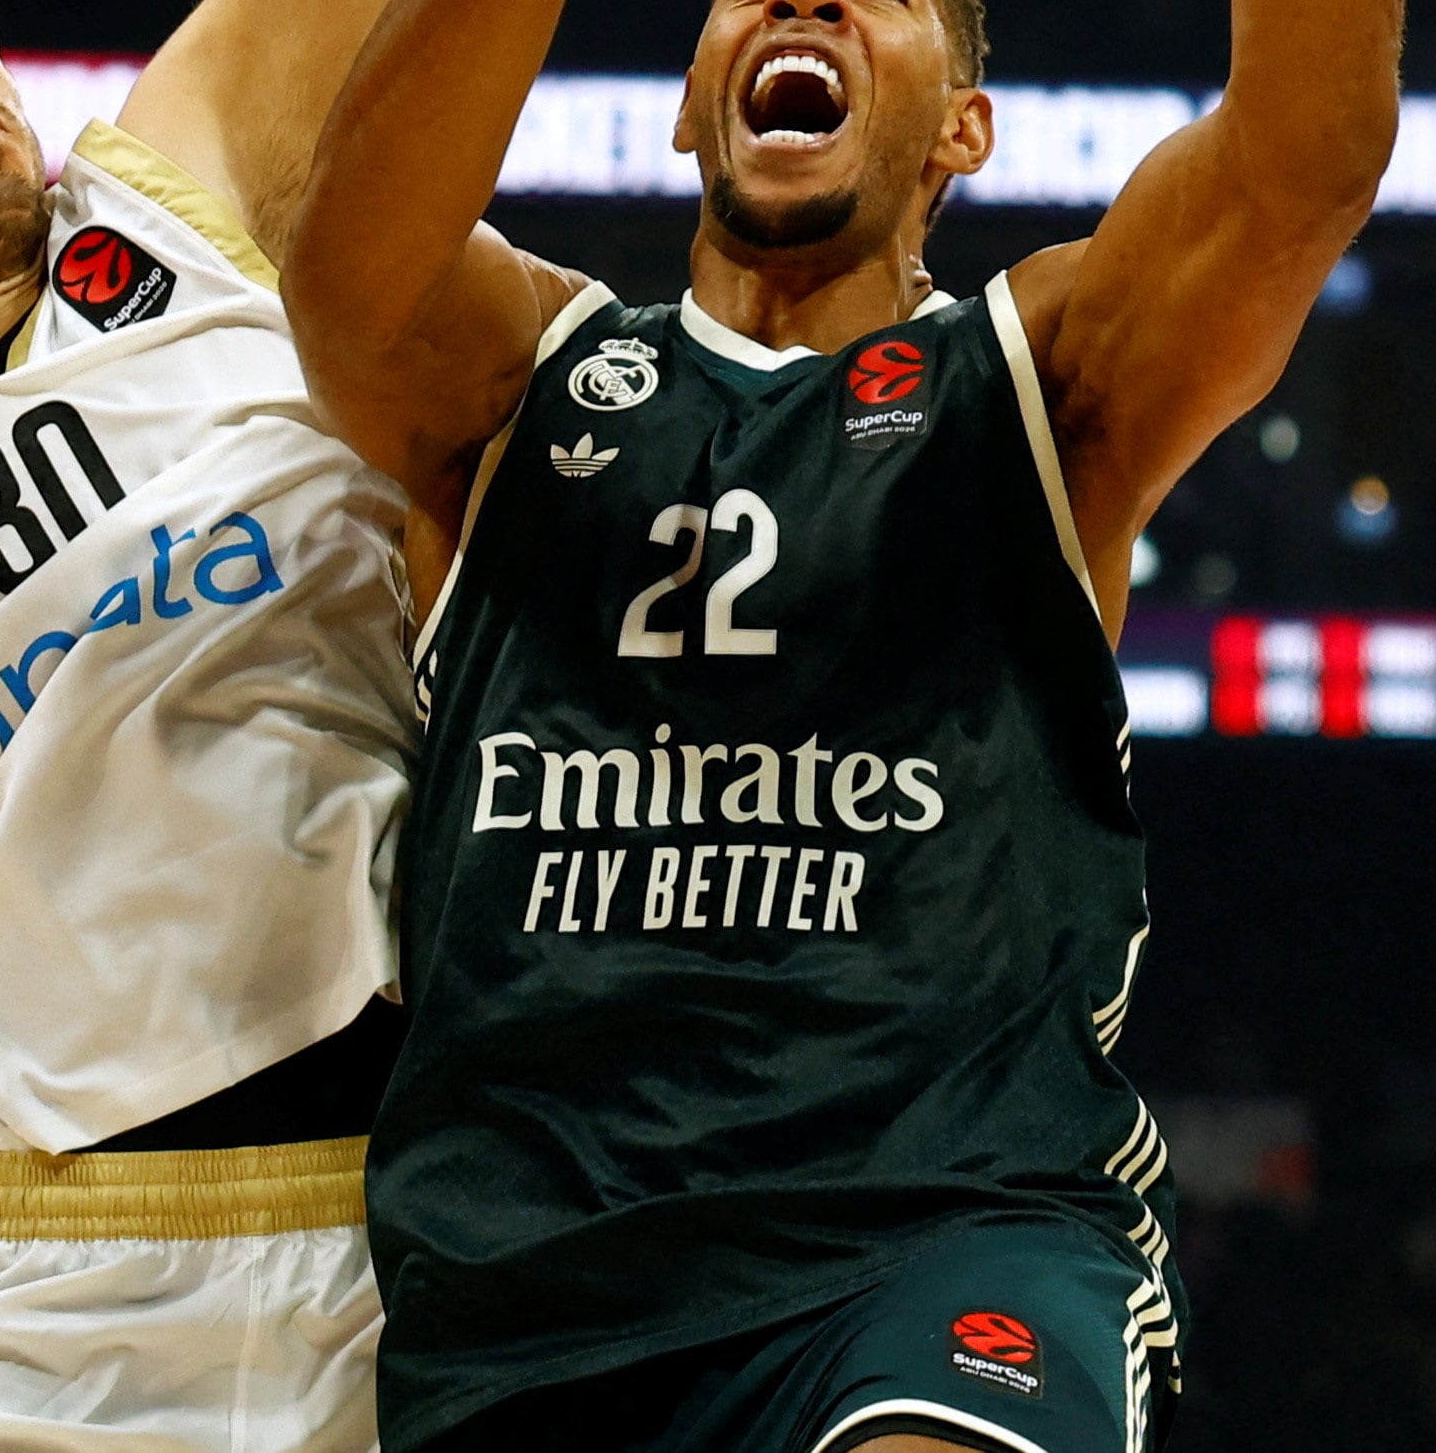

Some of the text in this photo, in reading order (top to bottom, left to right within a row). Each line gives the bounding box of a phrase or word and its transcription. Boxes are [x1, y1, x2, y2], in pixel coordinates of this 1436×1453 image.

[103, 267, 162, 331] SuperCup
[845, 410, 923, 432] SuperCup
[617, 488, 778, 658] 22
[472, 723, 944, 832] Emirates
[523, 845, 865, 933] FLY BETTER
[952, 1352, 1038, 1387] SuperCup
